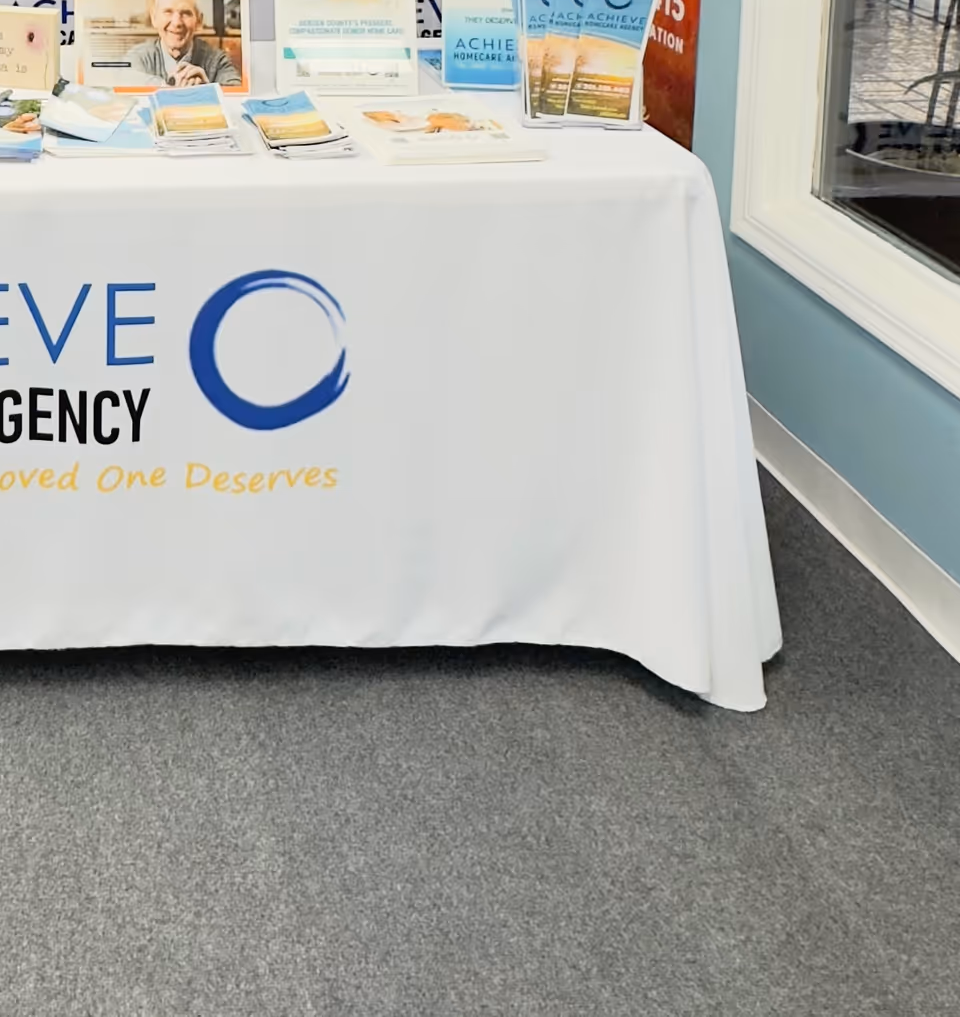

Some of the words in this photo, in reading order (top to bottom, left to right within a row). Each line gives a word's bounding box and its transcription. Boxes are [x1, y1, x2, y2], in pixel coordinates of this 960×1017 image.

[588, 13, 647, 24] ACHIEVE
[456, 38, 514, 51] ACHIE
[0, 45, 16, 57] my
[454, 53, 501, 61] HOMECARE
[16, 61, 28, 73] is
[96, 465, 165, 494] One
[185, 462, 337, 496] Deserves
